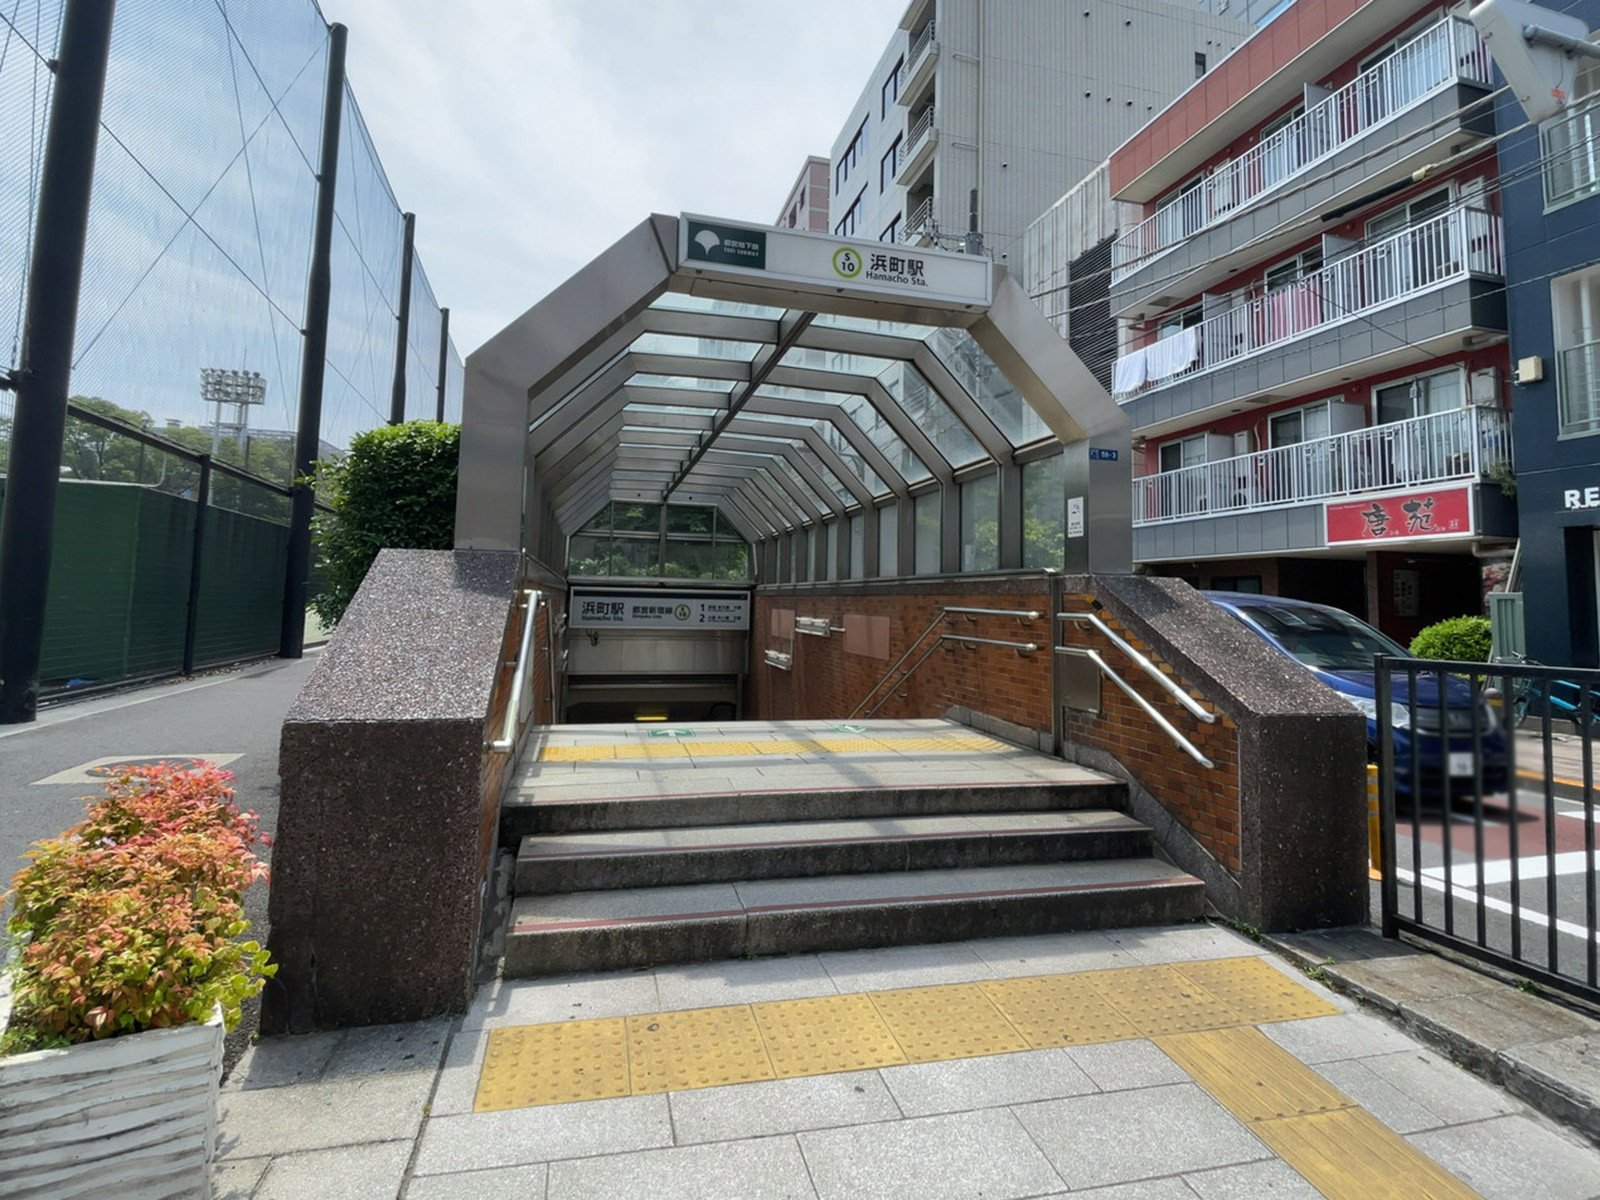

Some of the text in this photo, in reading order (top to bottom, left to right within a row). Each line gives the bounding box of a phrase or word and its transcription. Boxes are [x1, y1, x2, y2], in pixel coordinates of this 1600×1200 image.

[844, 252, 850, 261] S
[841, 262, 855, 272] 10
[870, 253, 924, 277] 浜町駅
[866, 271, 928, 287] Hamacho Sta.
[581, 601, 625, 615] 浜町駅
[699, 614, 705, 623] 2
